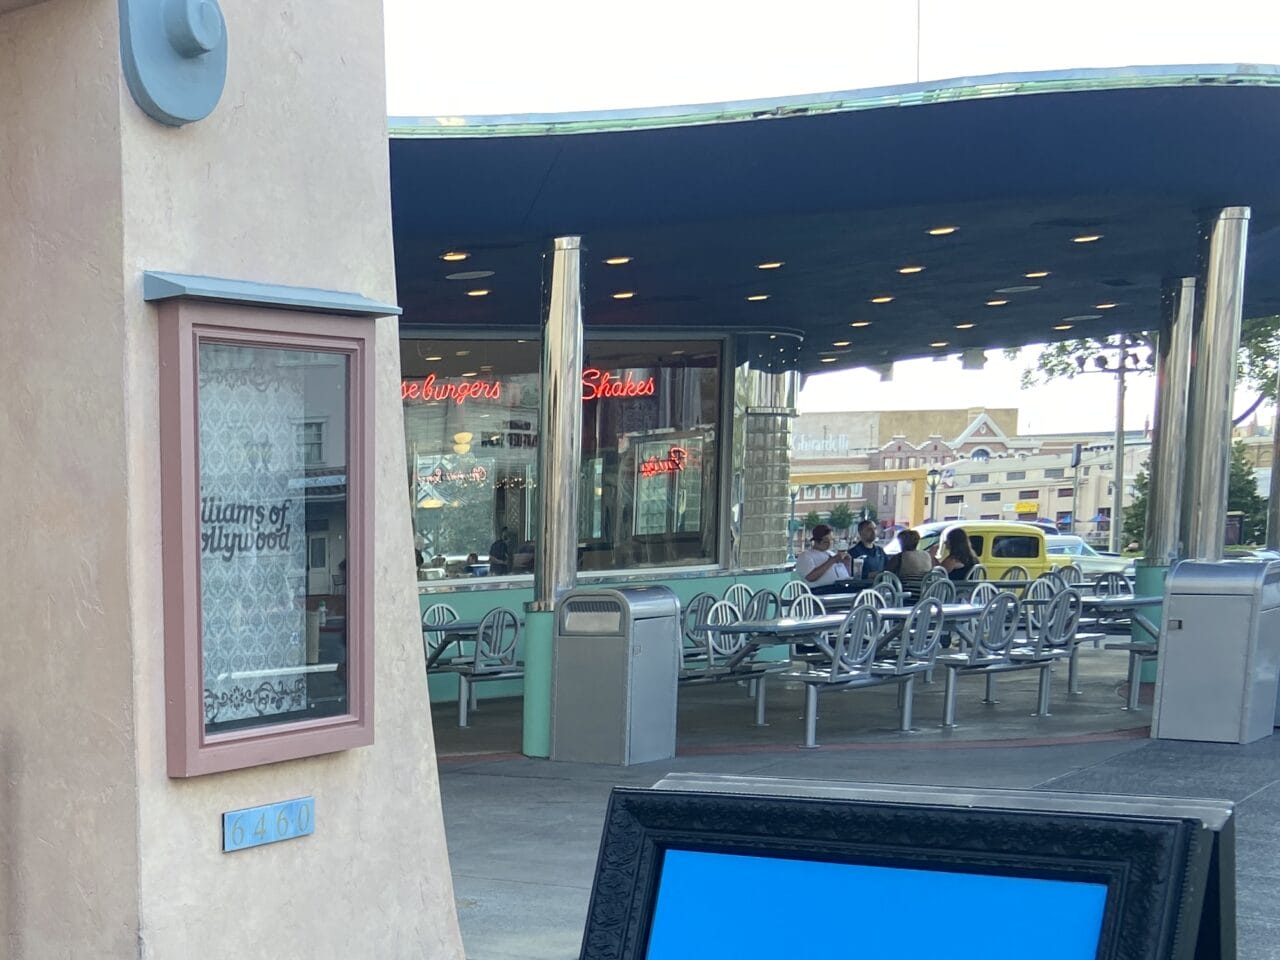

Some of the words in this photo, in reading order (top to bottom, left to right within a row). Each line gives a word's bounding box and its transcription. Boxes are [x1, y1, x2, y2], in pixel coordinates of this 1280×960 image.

[582, 368, 656, 401] Shakes
[269, 499, 292, 533] of
[231, 803, 311, 847] 6460
